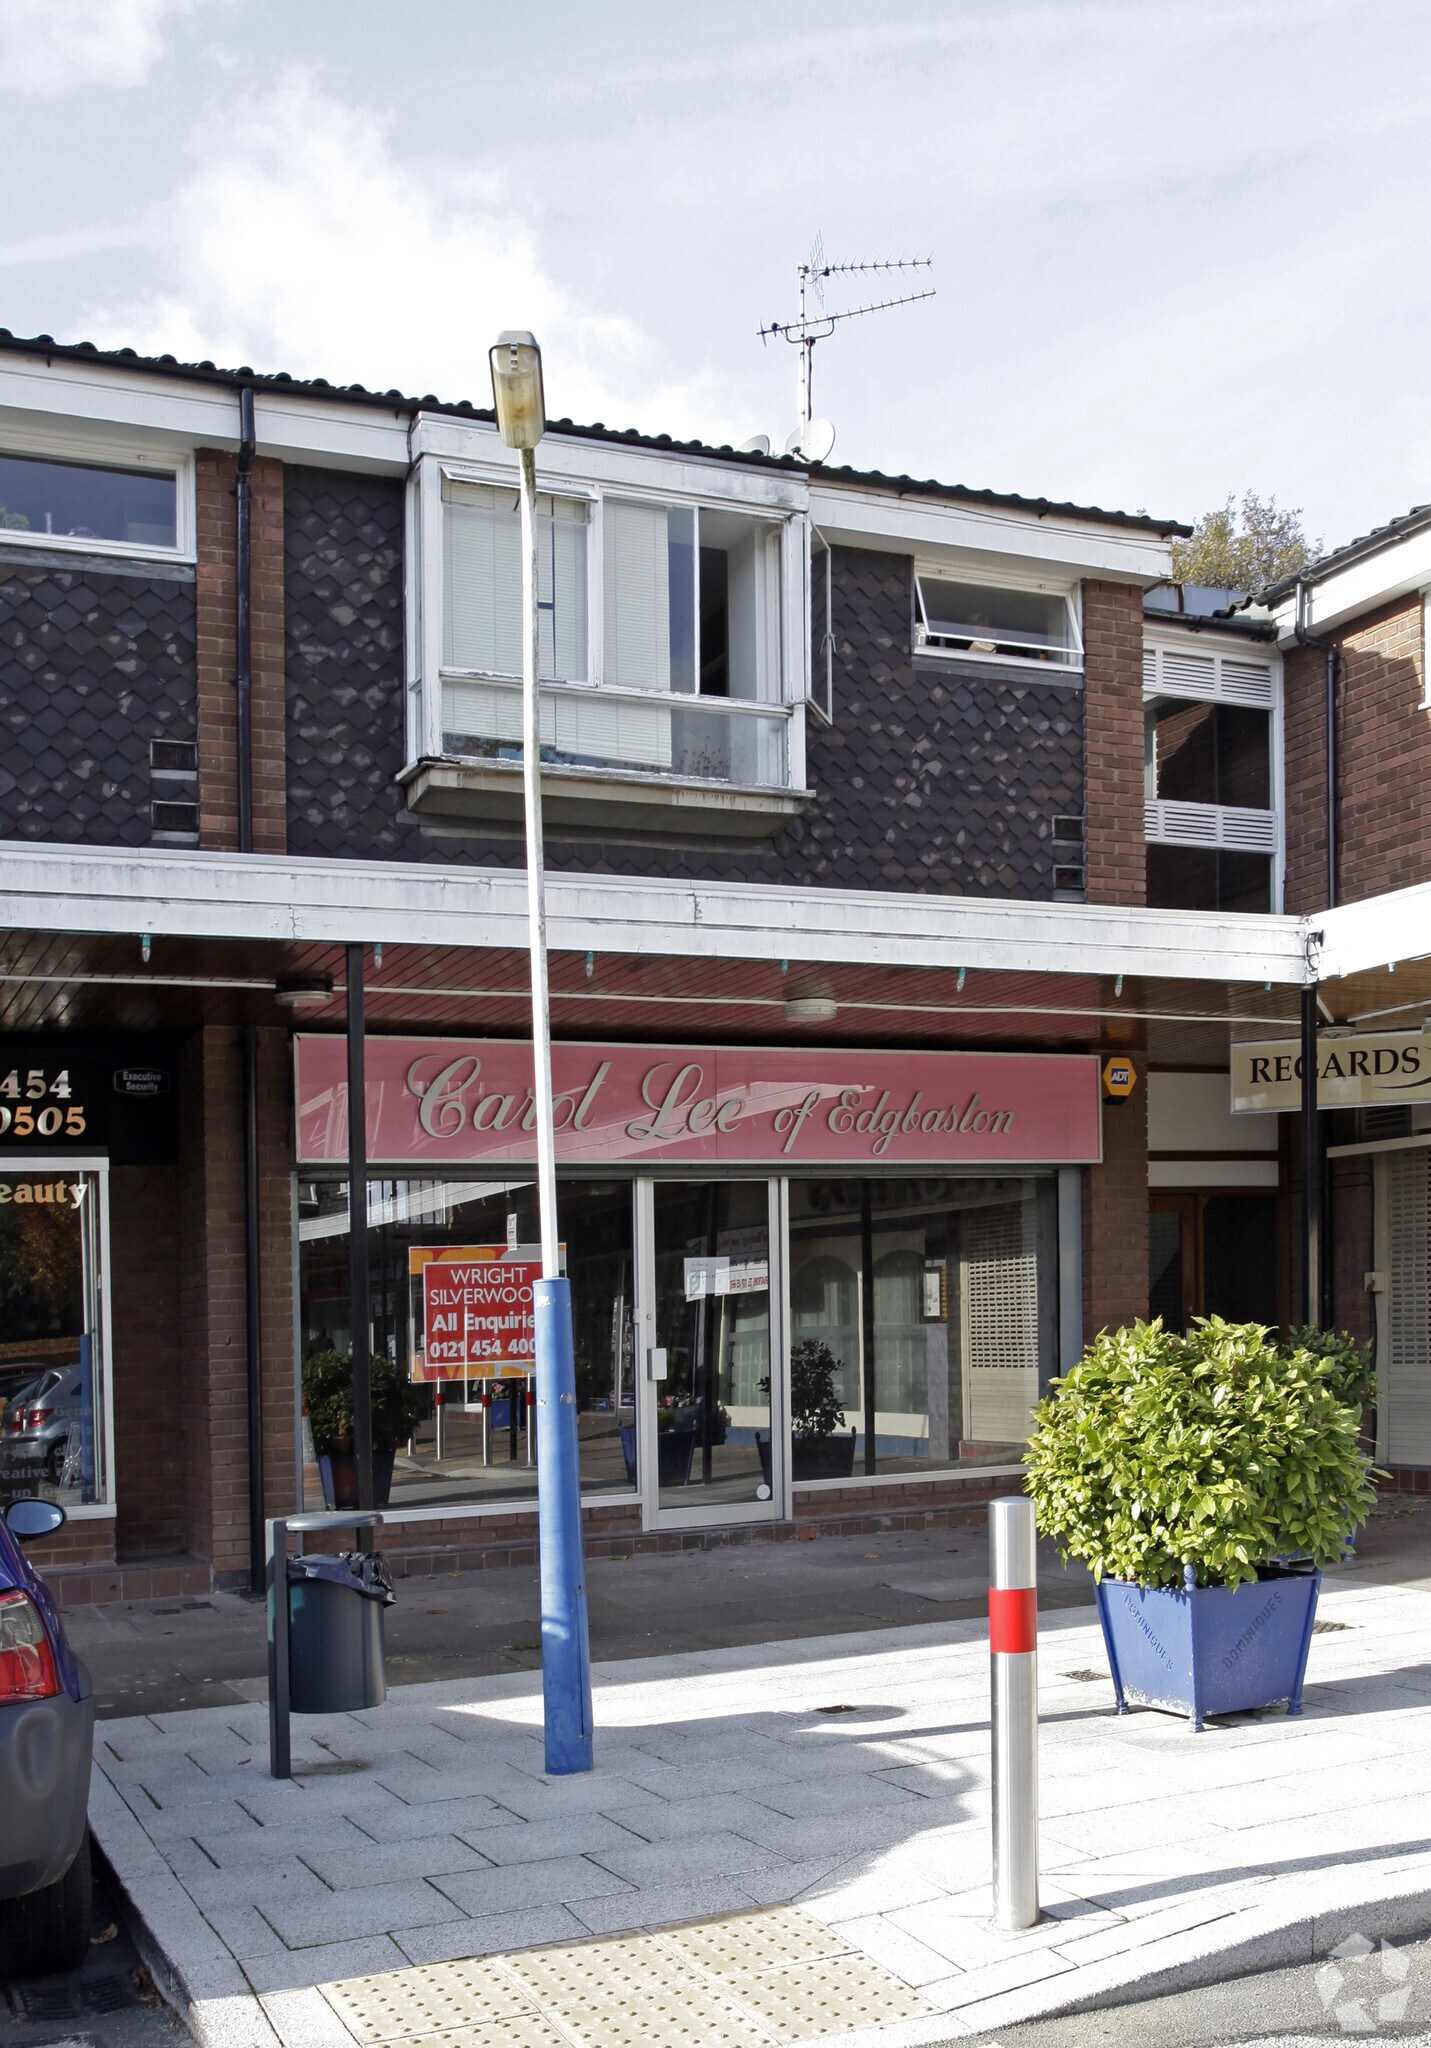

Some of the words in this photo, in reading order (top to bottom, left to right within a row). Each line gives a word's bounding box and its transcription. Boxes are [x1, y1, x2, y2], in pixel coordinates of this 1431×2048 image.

[0, 1069, 72, 1100] 454
[122, 1071, 162, 1082] Executive
[1110, 1071, 1129, 1082] ADT
[125, 1081, 160, 1093] Security
[407, 1055, 613, 1139] Carol
[625, 1062, 745, 1140] Lee
[773, 1089, 822, 1154] of
[828, 1088, 1016, 1156] Edgbaston
[450, 1267, 528, 1285] WRIGHT
[430, 1286, 534, 1306] SILVERWOO
[431, 1312, 458, 1332] All
[465, 1311, 536, 1334] Enquirie
[430, 1341, 466, 1359] 0121
[470, 1338, 503, 1356] 454
[507, 1338, 536, 1355] 400
[0, 1466, 50, 1479] eative
